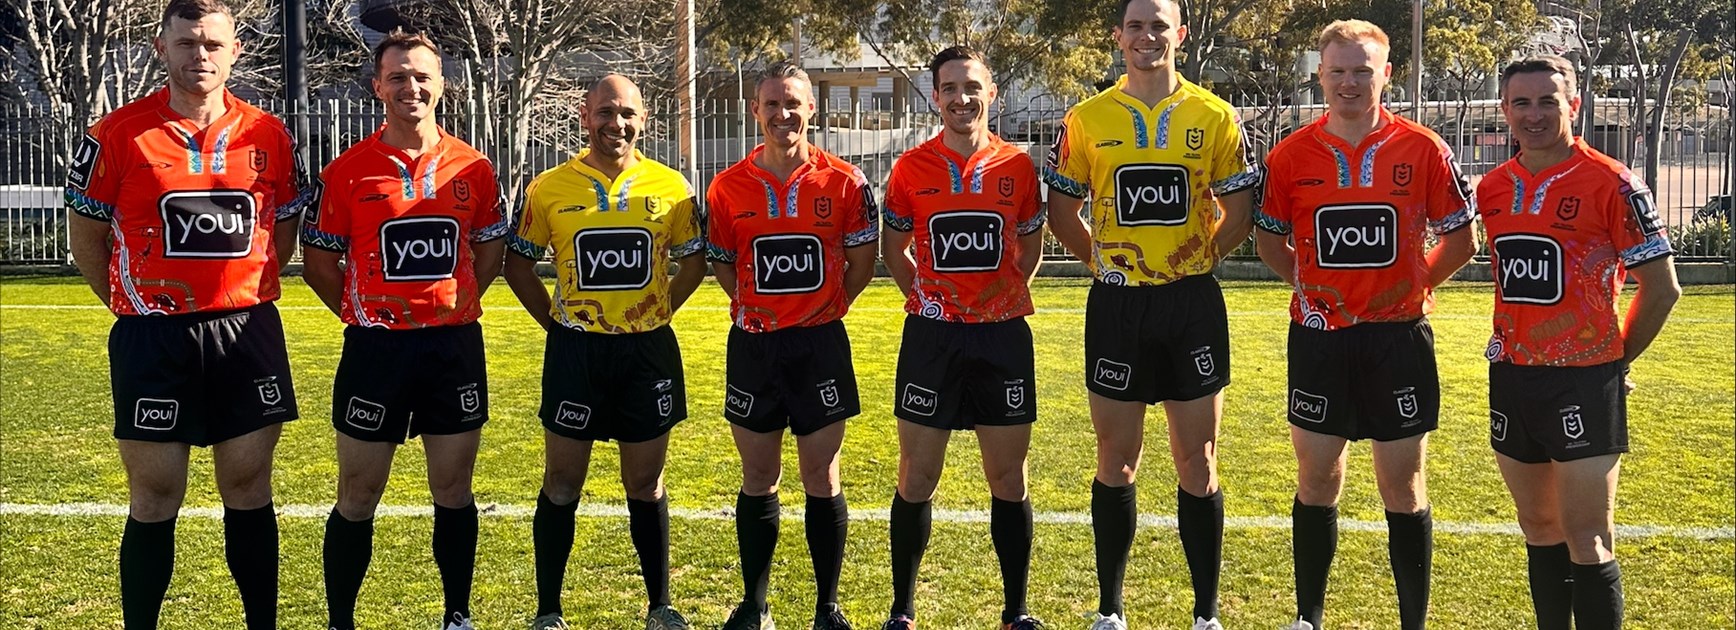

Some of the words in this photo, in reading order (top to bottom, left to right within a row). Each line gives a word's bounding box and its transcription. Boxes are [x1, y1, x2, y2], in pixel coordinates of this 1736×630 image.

[1125, 176, 1180, 215] youi
[176, 204, 244, 243] youi
[940, 223, 994, 260] youi
[1325, 216, 1386, 256] youi
[392, 228, 451, 270] youi
[586, 240, 642, 278] youi
[762, 245, 813, 282] youi
[1502, 249, 1548, 288] youi
[1098, 367, 1125, 382] youi
[141, 405, 173, 423] youi
[350, 406, 381, 422] youi
[562, 408, 586, 422] youi
[727, 391, 748, 410] youi
[908, 391, 933, 408] youi
[1295, 396, 1322, 414] youi
